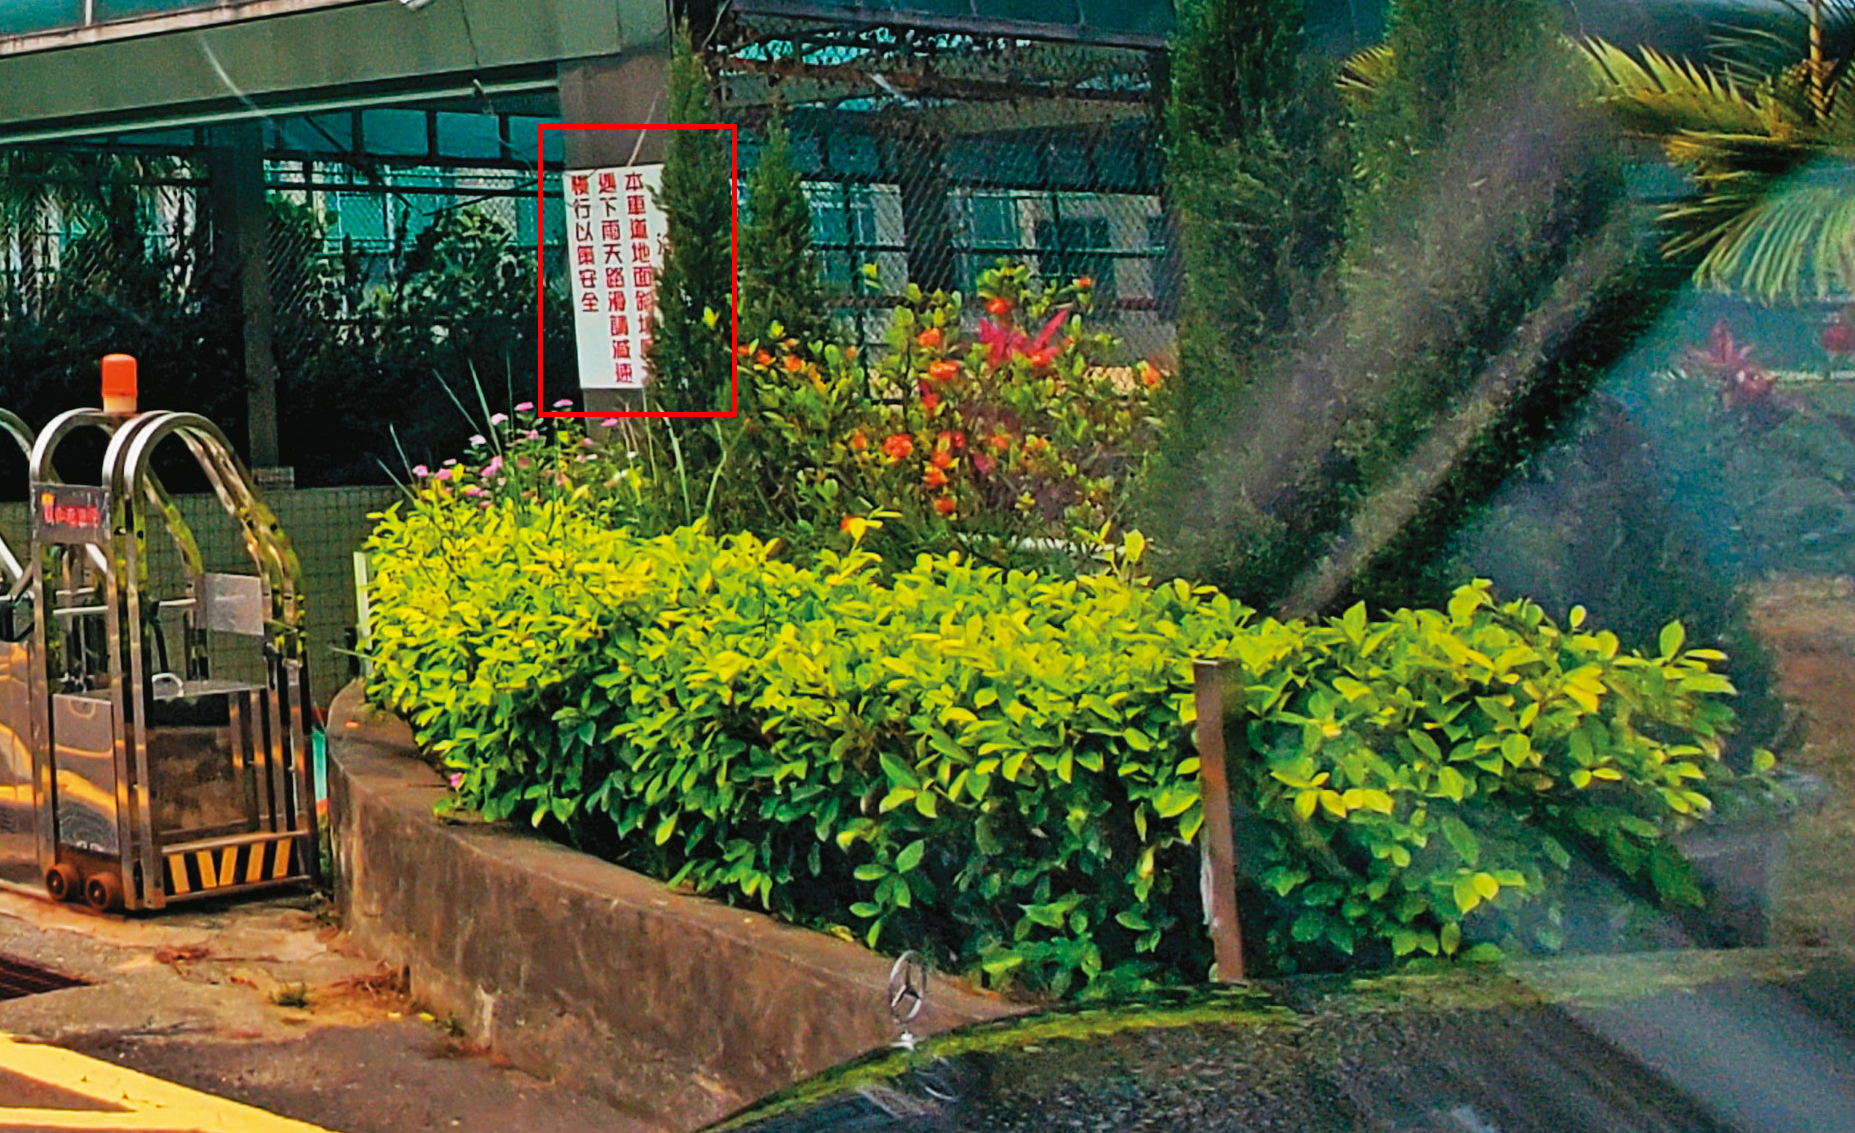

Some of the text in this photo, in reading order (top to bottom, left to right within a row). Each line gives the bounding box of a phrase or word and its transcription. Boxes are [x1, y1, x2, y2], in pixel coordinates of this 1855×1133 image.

[571, 175, 598, 312] 慢行以策安全
